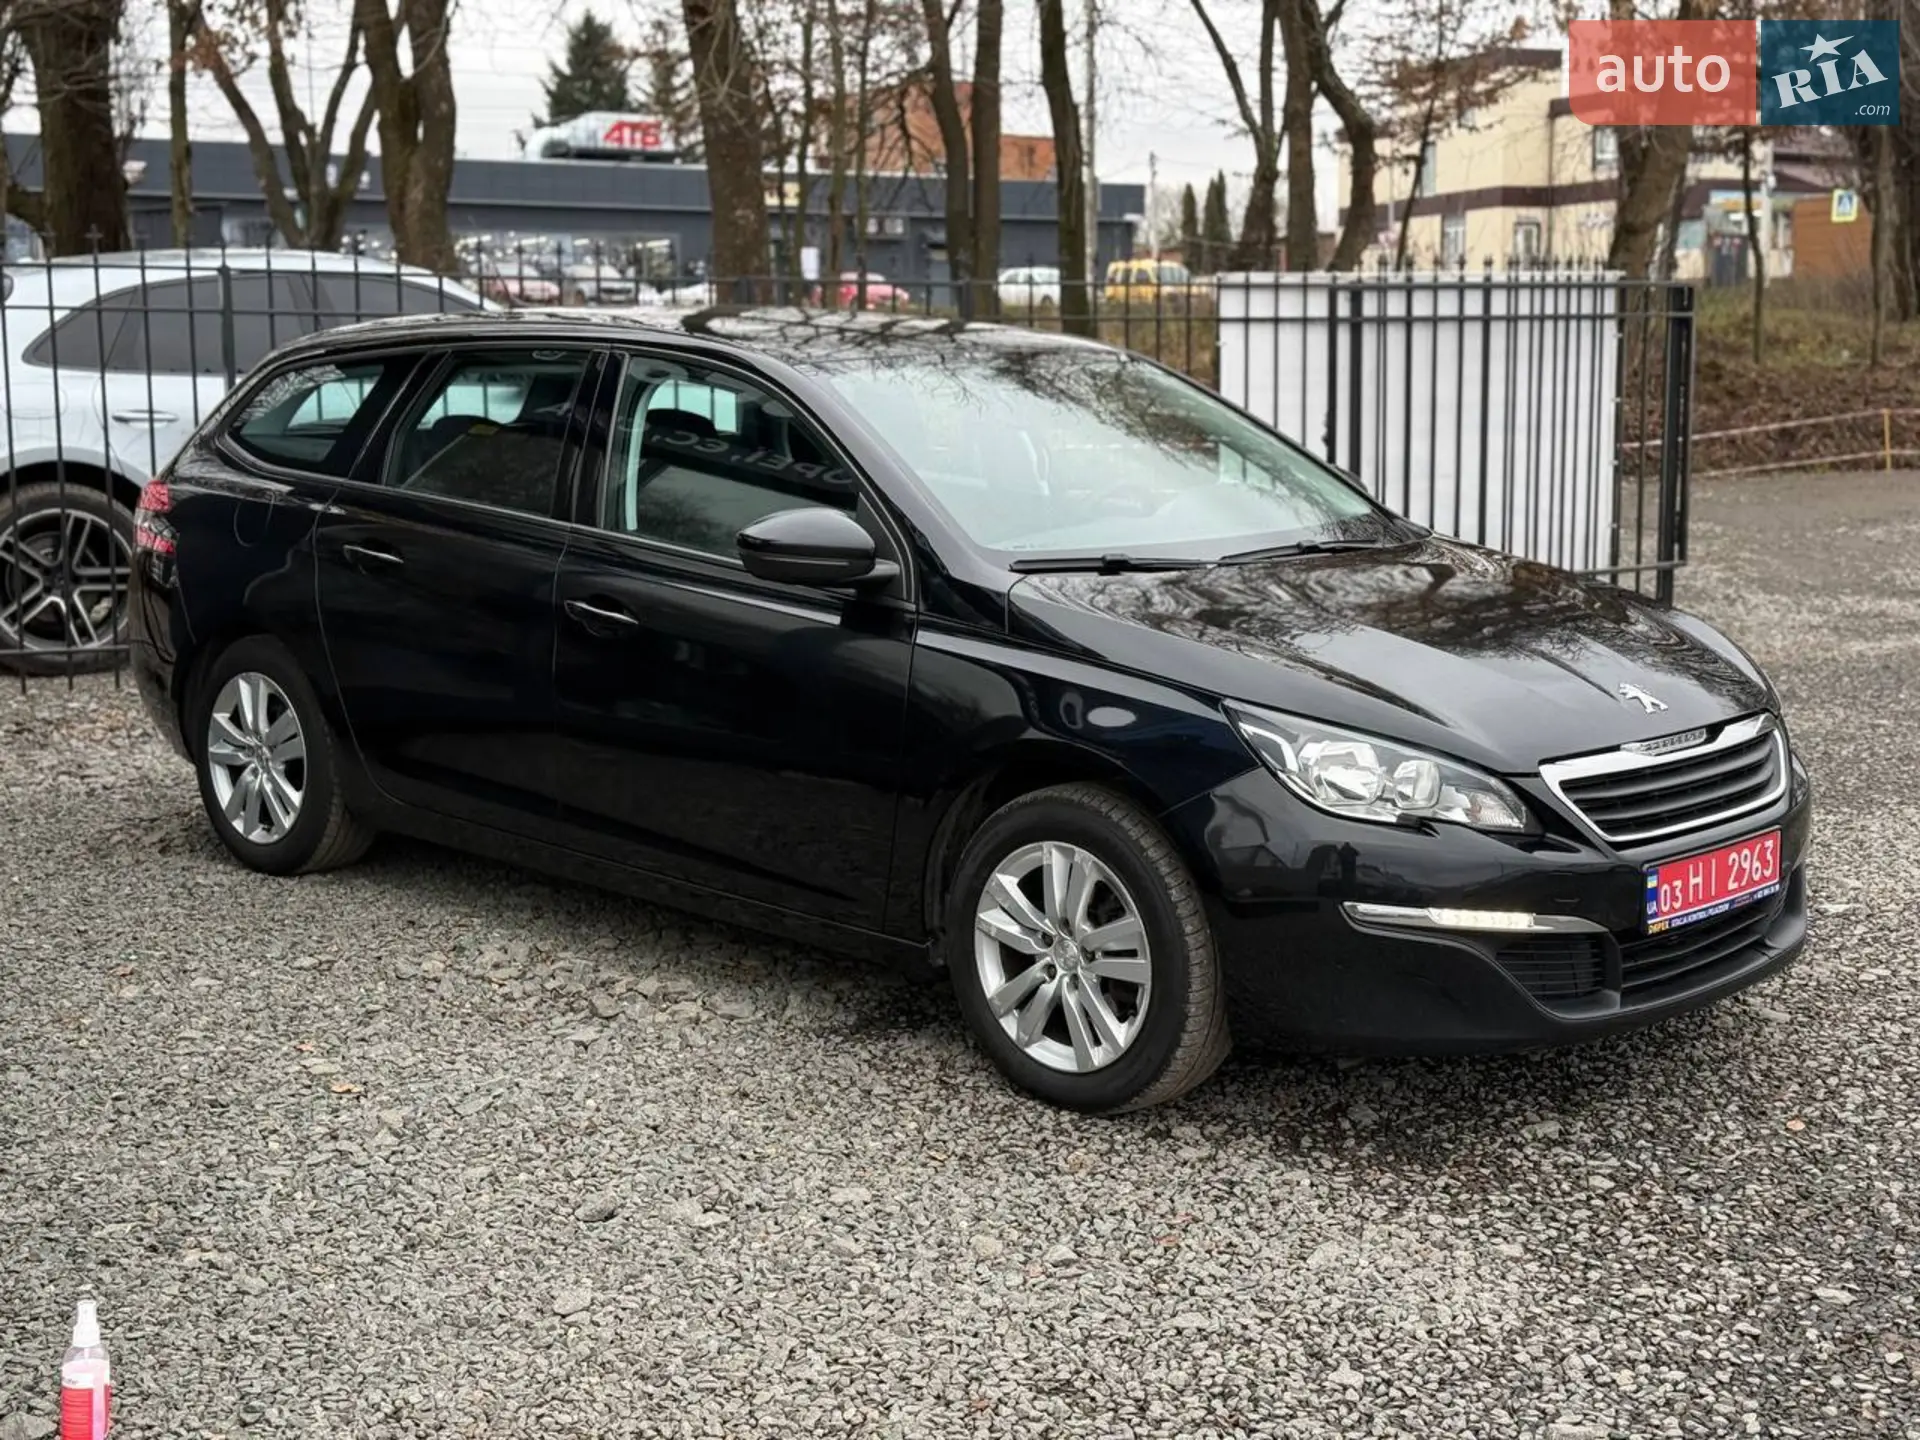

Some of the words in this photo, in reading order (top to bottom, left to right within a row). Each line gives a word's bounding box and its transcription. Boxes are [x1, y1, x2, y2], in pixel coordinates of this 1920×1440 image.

[1660, 879, 1682, 913] 03
[1727, 839, 1774, 891] 2963
[1646, 901, 1658, 915] UA
